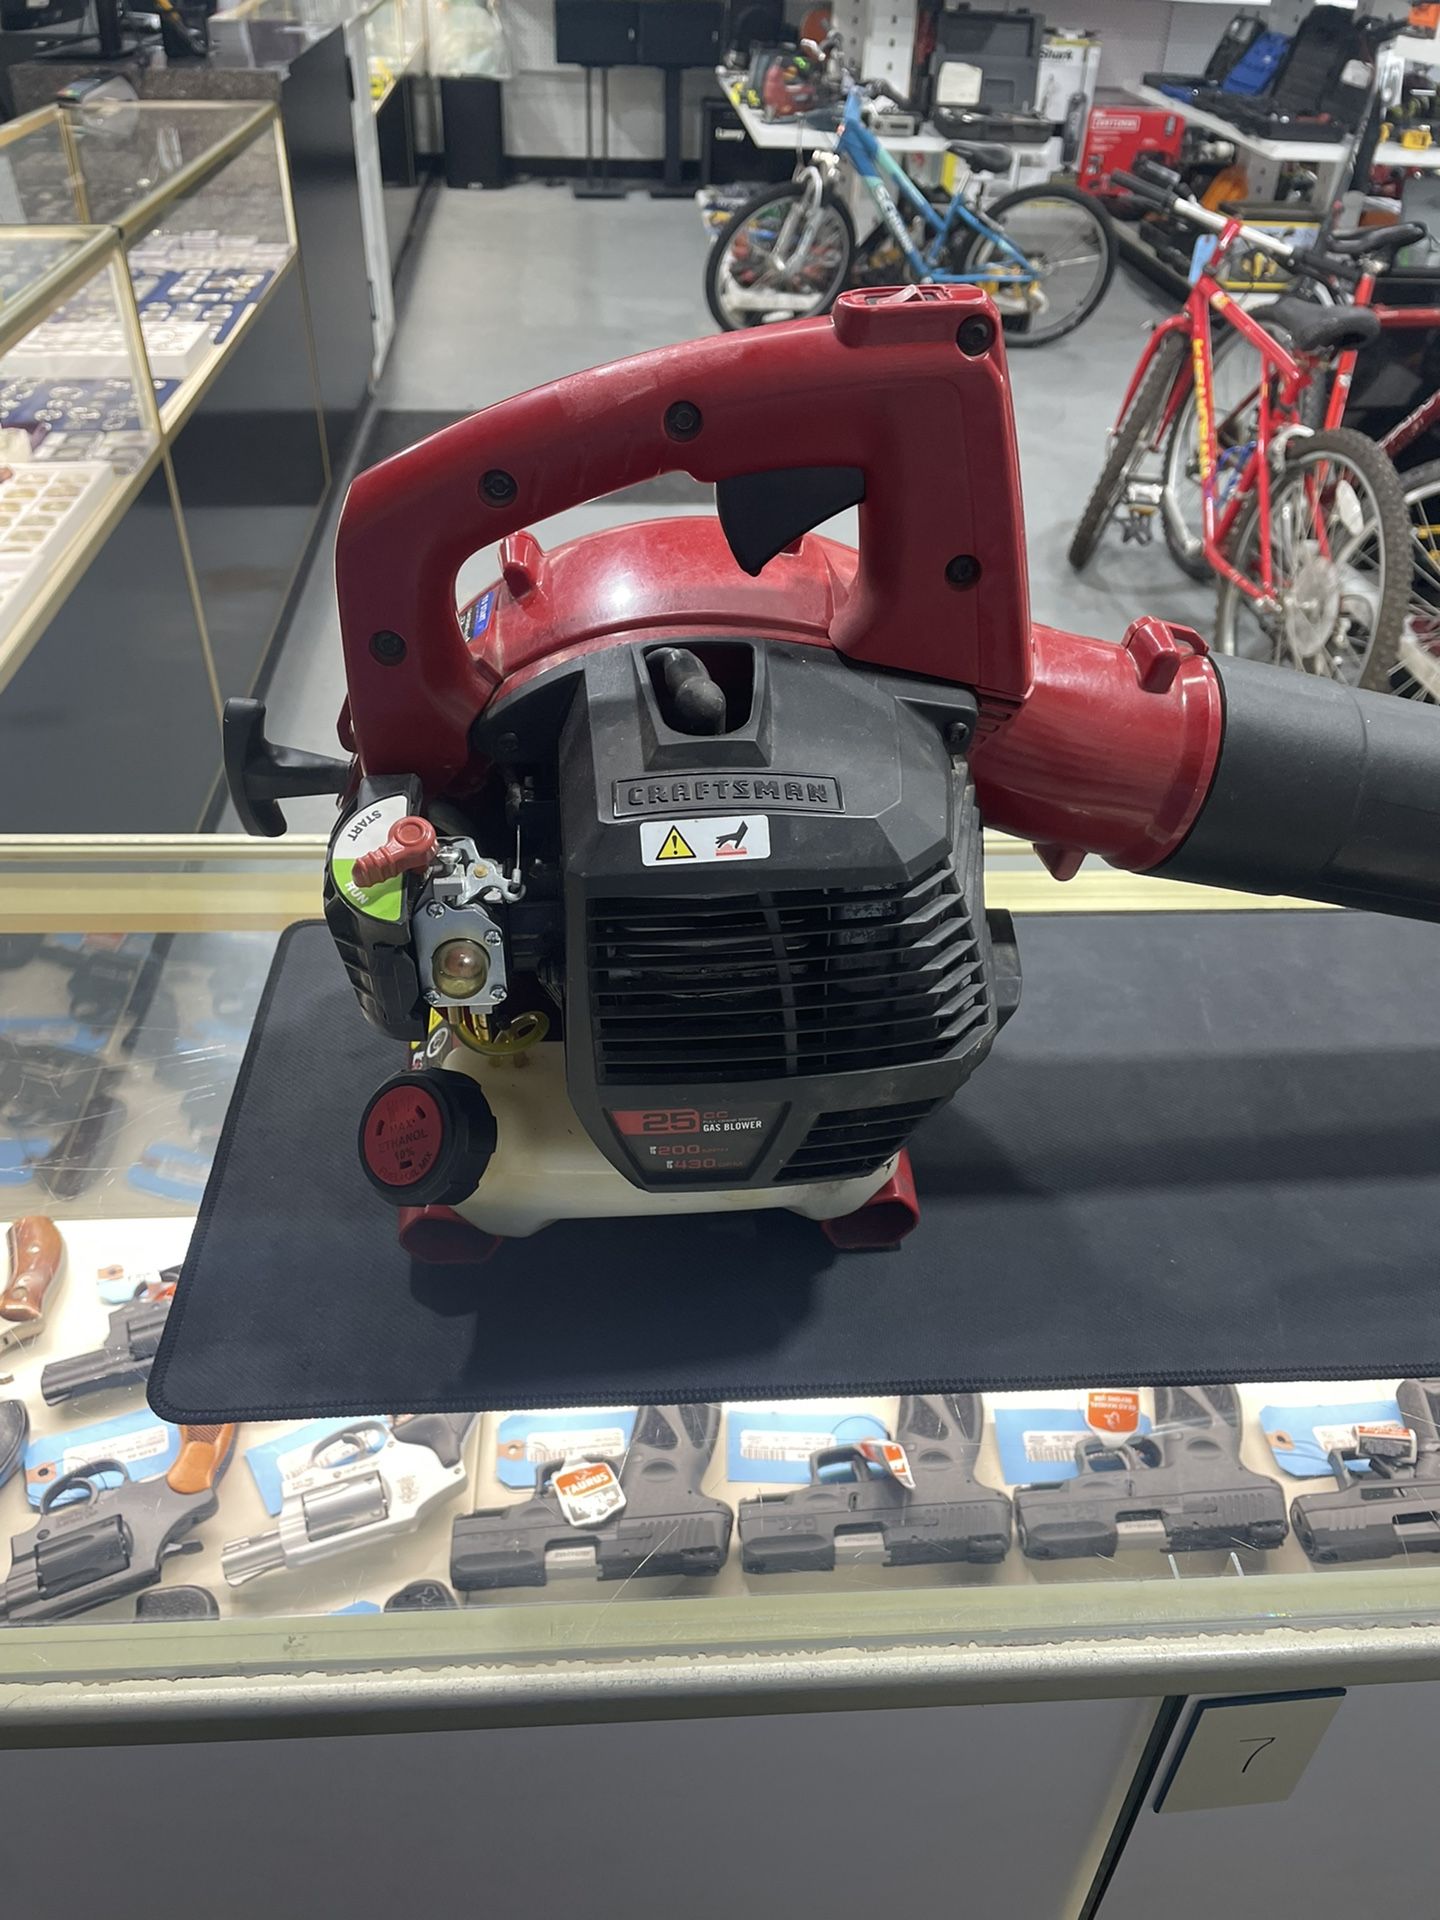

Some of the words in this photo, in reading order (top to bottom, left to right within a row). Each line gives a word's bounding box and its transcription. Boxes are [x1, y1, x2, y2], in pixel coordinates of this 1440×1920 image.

[627, 780, 828, 806] CRAFTSMAN
[347, 809, 382, 842] START
[345, 880, 369, 905] RUN
[642, 1111, 697, 1132] 25
[703, 1122, 722, 1132] GAS
[724, 1120, 763, 1131] BLOWER
[378, 1128, 429, 1153] ETHANOL
[658, 1144, 700, 1156] 200
[674, 1158, 717, 1169] 430
[562, 1471, 610, 1497] TAURUS
[1239, 1736, 1277, 1774] 7
